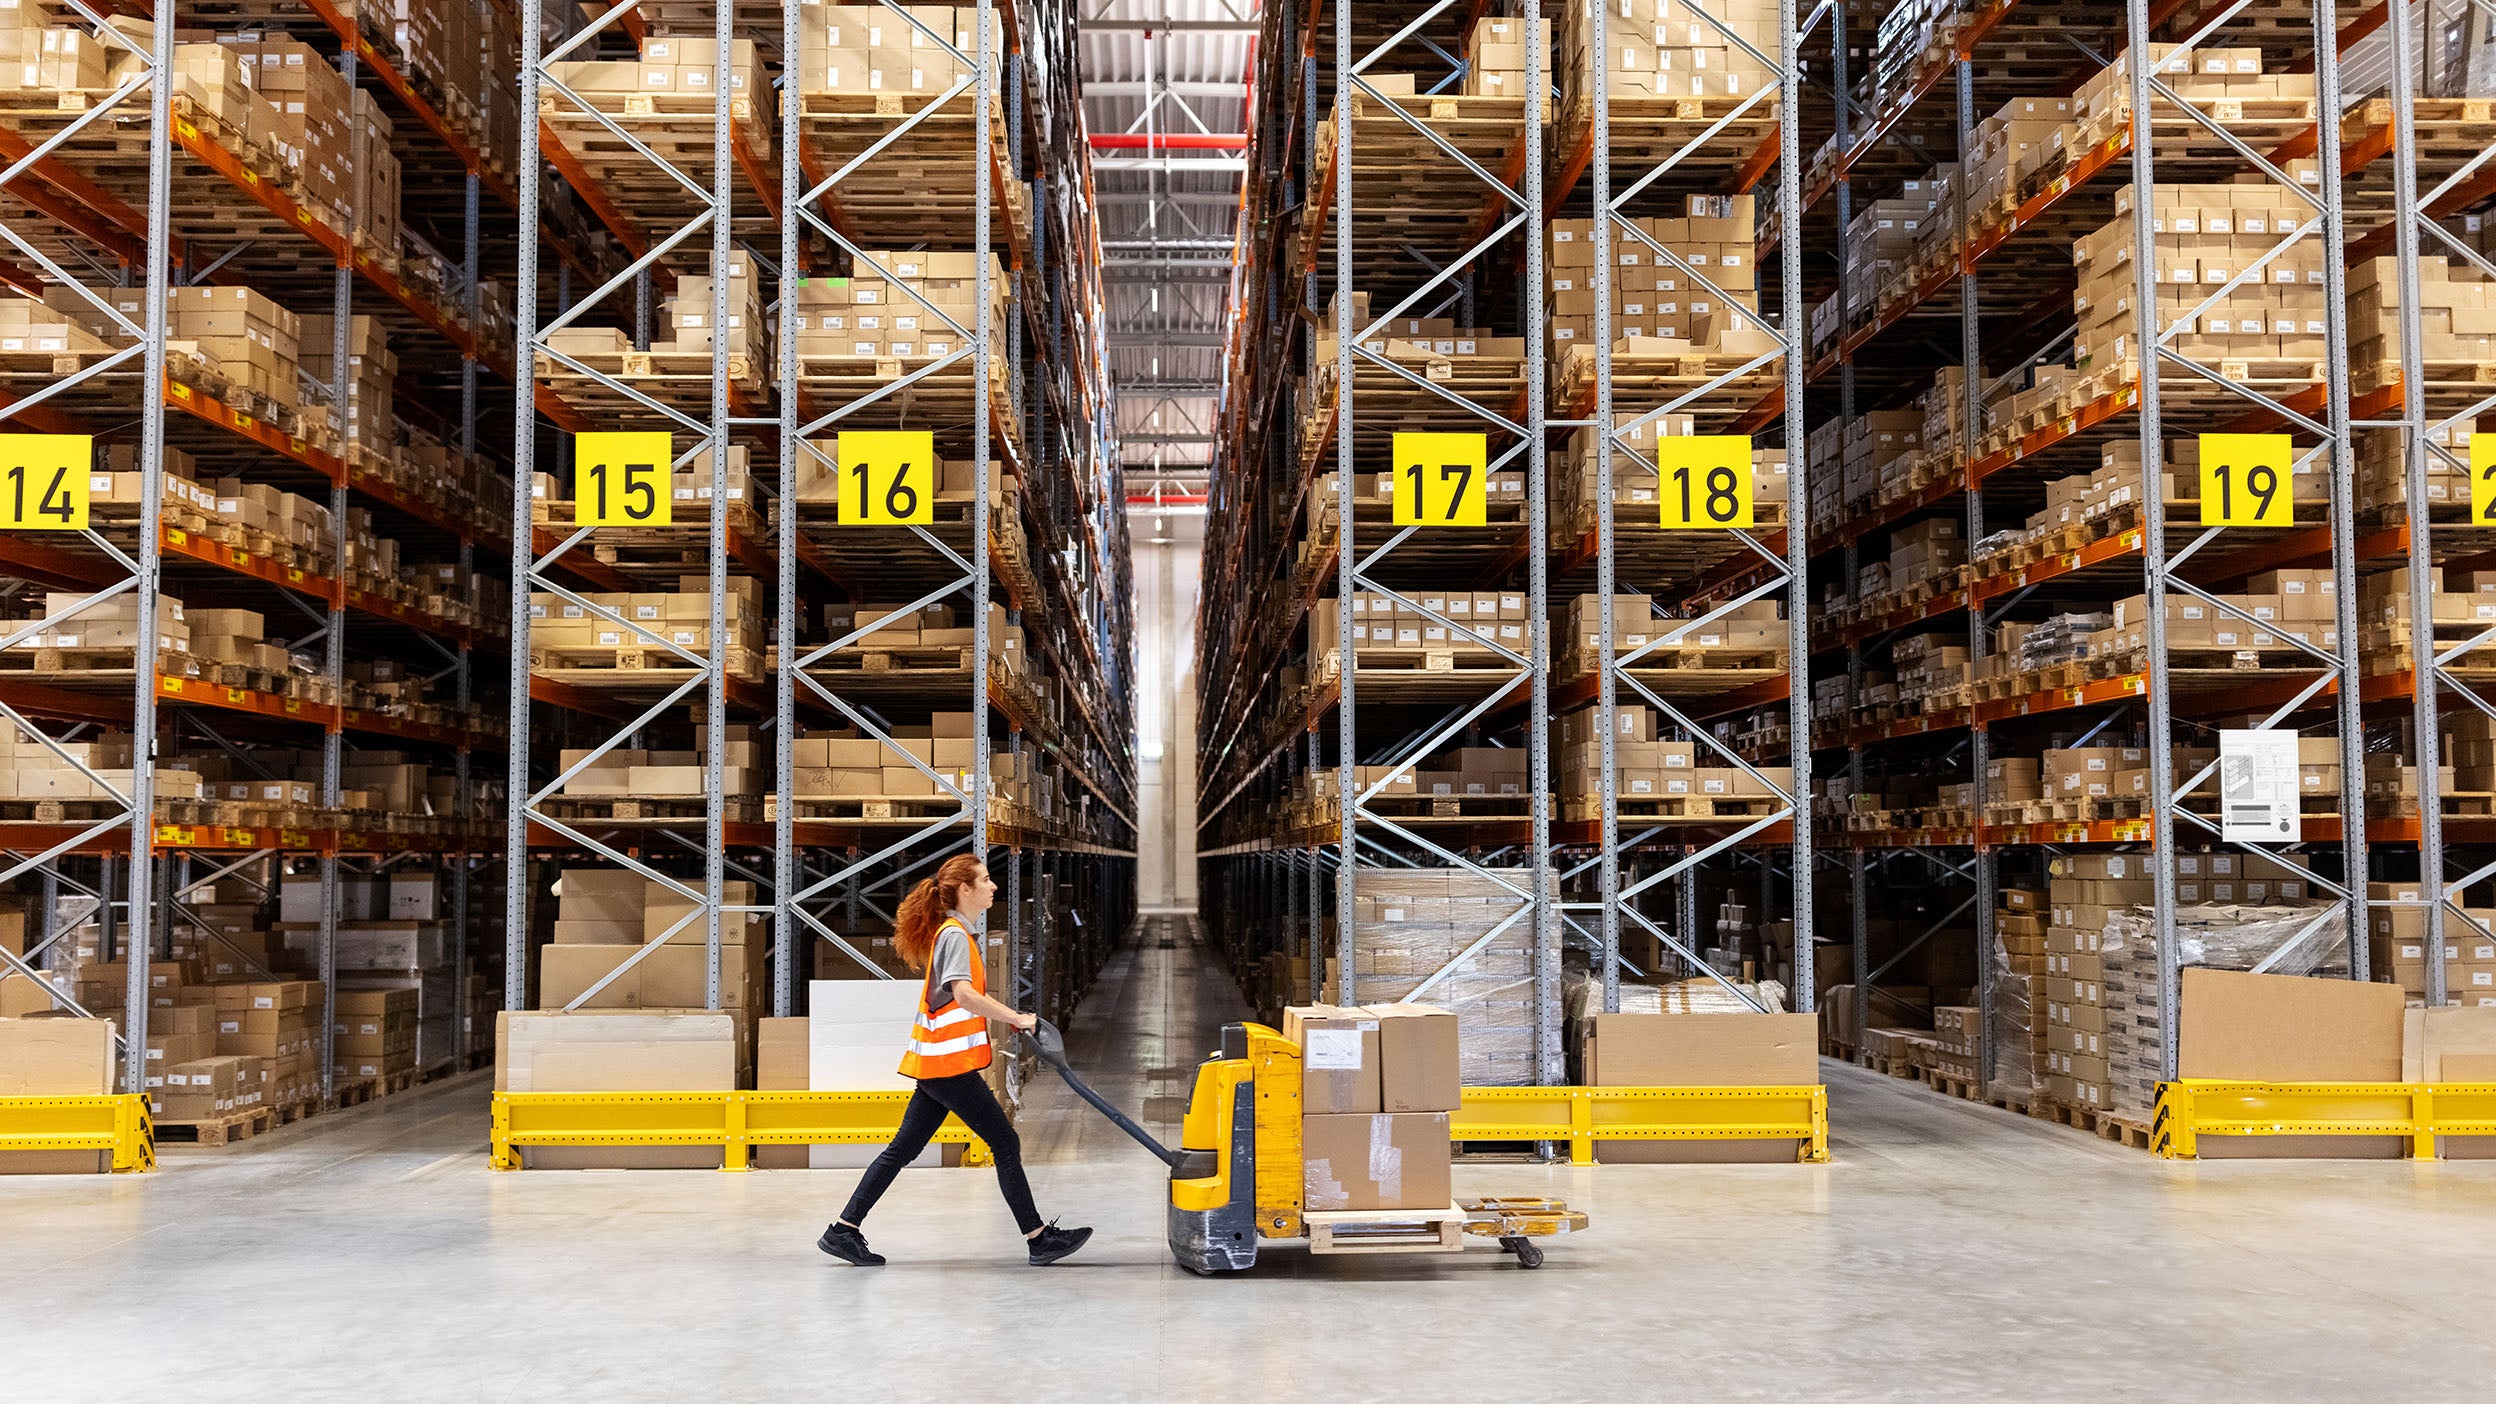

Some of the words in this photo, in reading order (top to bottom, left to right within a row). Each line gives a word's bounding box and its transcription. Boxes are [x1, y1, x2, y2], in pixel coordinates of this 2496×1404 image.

[8, 466, 75, 523] 14
[590, 463, 655, 520] 15
[852, 463, 917, 519] 16
[1407, 464, 1472, 520] 17
[1673, 466, 1739, 523] 18
[2214, 465, 2278, 520] 19
